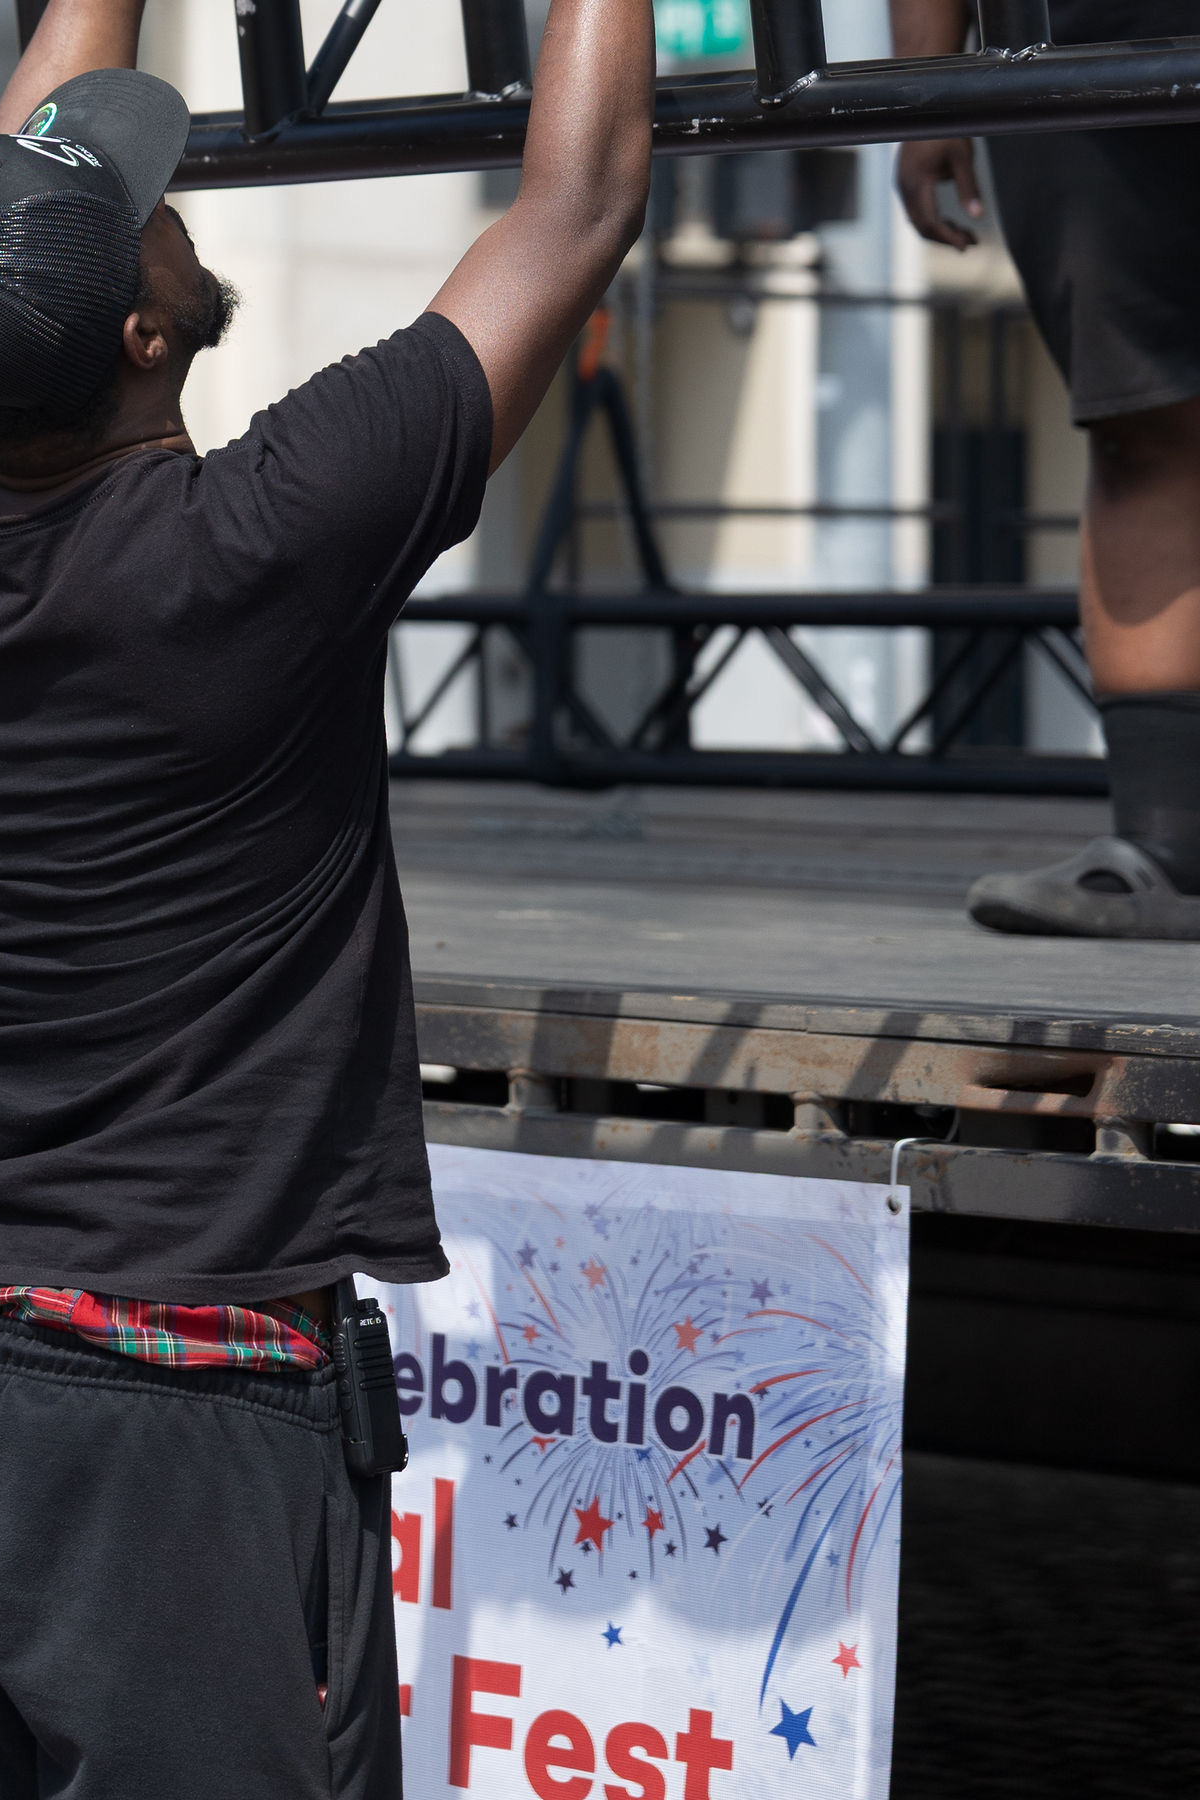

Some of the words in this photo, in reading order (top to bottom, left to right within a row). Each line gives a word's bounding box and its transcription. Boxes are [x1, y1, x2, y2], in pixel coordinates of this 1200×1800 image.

[394, 1331, 756, 1461] ebration
[391, 1476, 456, 1612] al
[447, 1653, 735, 1800] Fest
